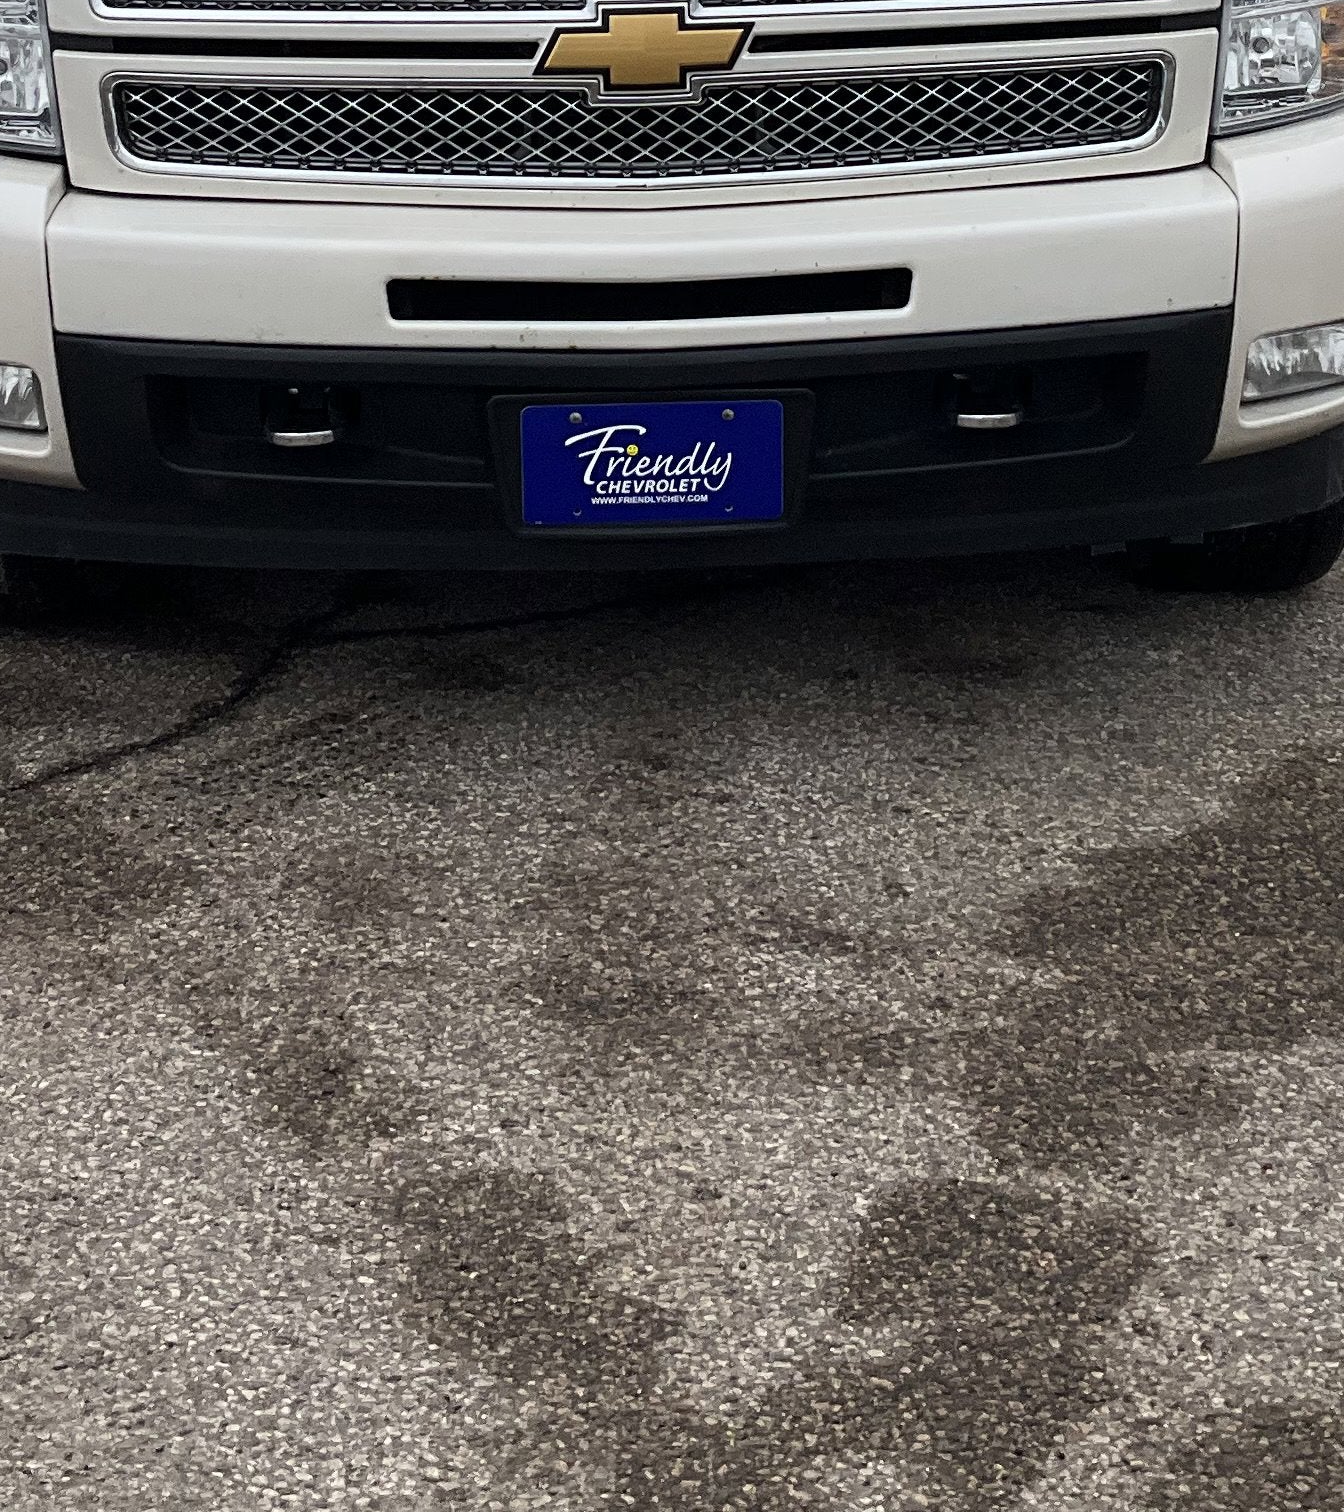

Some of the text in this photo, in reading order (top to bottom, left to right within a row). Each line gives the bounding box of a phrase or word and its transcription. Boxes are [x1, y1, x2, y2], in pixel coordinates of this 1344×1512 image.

[564, 424, 732, 492] Friendly
[596, 478, 701, 494] CHEVROLET
[591, 494, 709, 505] WWW.FRIENDLYCHEV.COM
